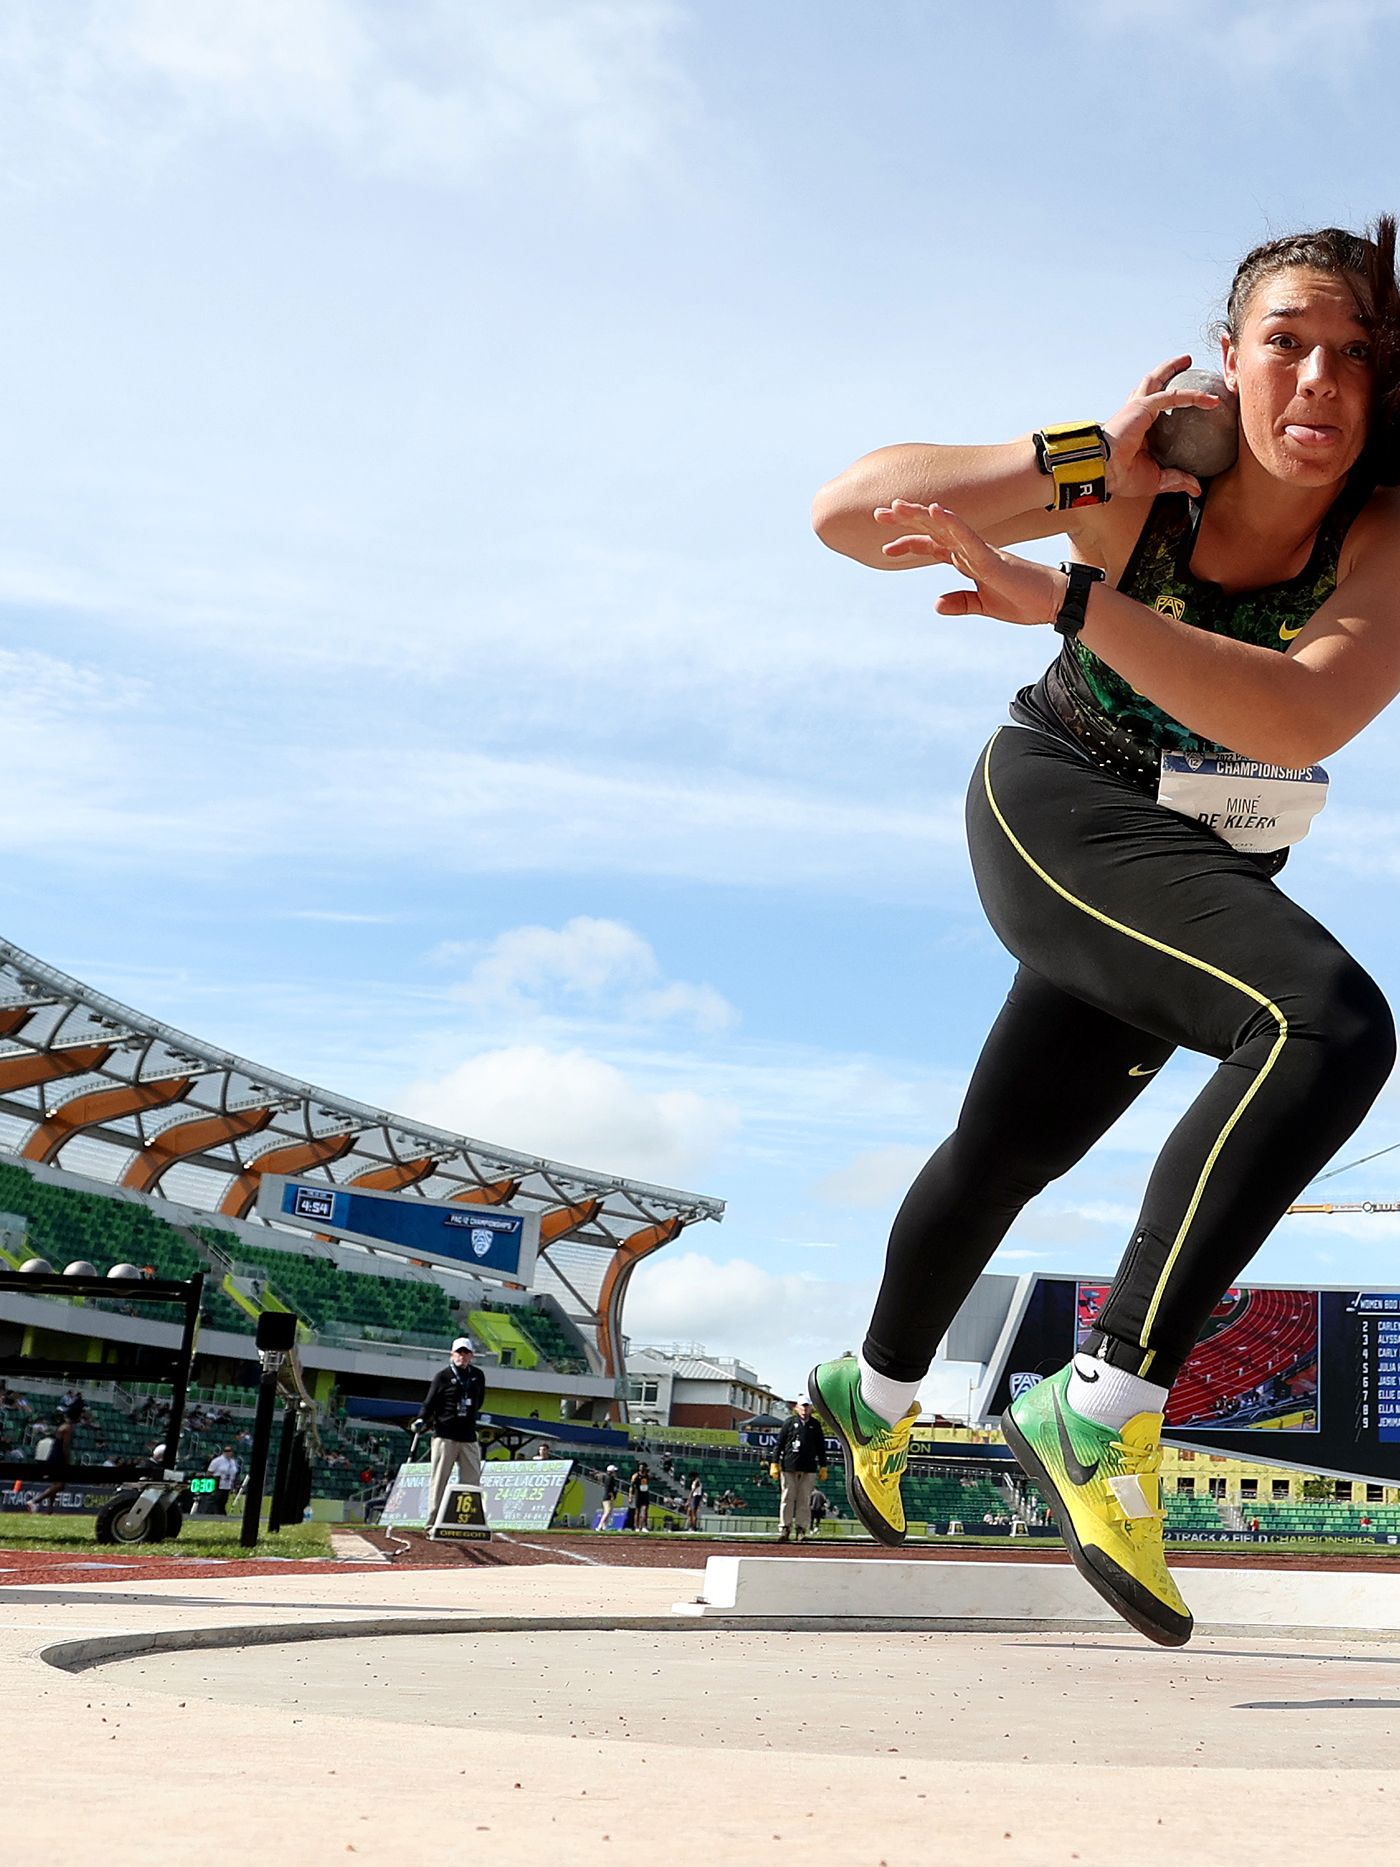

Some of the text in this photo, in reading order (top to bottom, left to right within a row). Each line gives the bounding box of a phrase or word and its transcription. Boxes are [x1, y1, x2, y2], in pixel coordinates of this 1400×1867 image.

[1079, 483, 1093, 497] R
[1216, 761, 1313, 781] CHAMPIONSHIPS
[1226, 794, 1262, 815] MINÉ
[1199, 813, 1281, 829] DE KLERK
[301, 1200, 329, 1215] 4:54
[1360, 1299, 1383, 1310] WOMEN
[1362, 1321, 1369, 1332] 2
[1362, 1335, 1369, 1346] 3
[1362, 1348, 1369, 1360] 4
[1362, 1362, 1369, 1374] 5
[1362, 1376, 1369, 1388] 6
[1362, 1390, 1369, 1402] 7
[1378, 1390, 1396, 1400] ELLIE
[1362, 1404, 1369, 1415] 8
[1378, 1404, 1394, 1414] ELLA
[1362, 1417, 1369, 1429] 9
[882, 1451, 907, 1475] NI
[190, 1479, 215, 1493] 0:30
[456, 1495, 473, 1513] 16
[1173, 1532, 1216, 1543] TRACK
[1219, 1533, 1230, 1543] &
[1232, 1533, 1268, 1544] FIELD
[1270, 1534, 1376, 1545] CHAMPIONSHIPS
